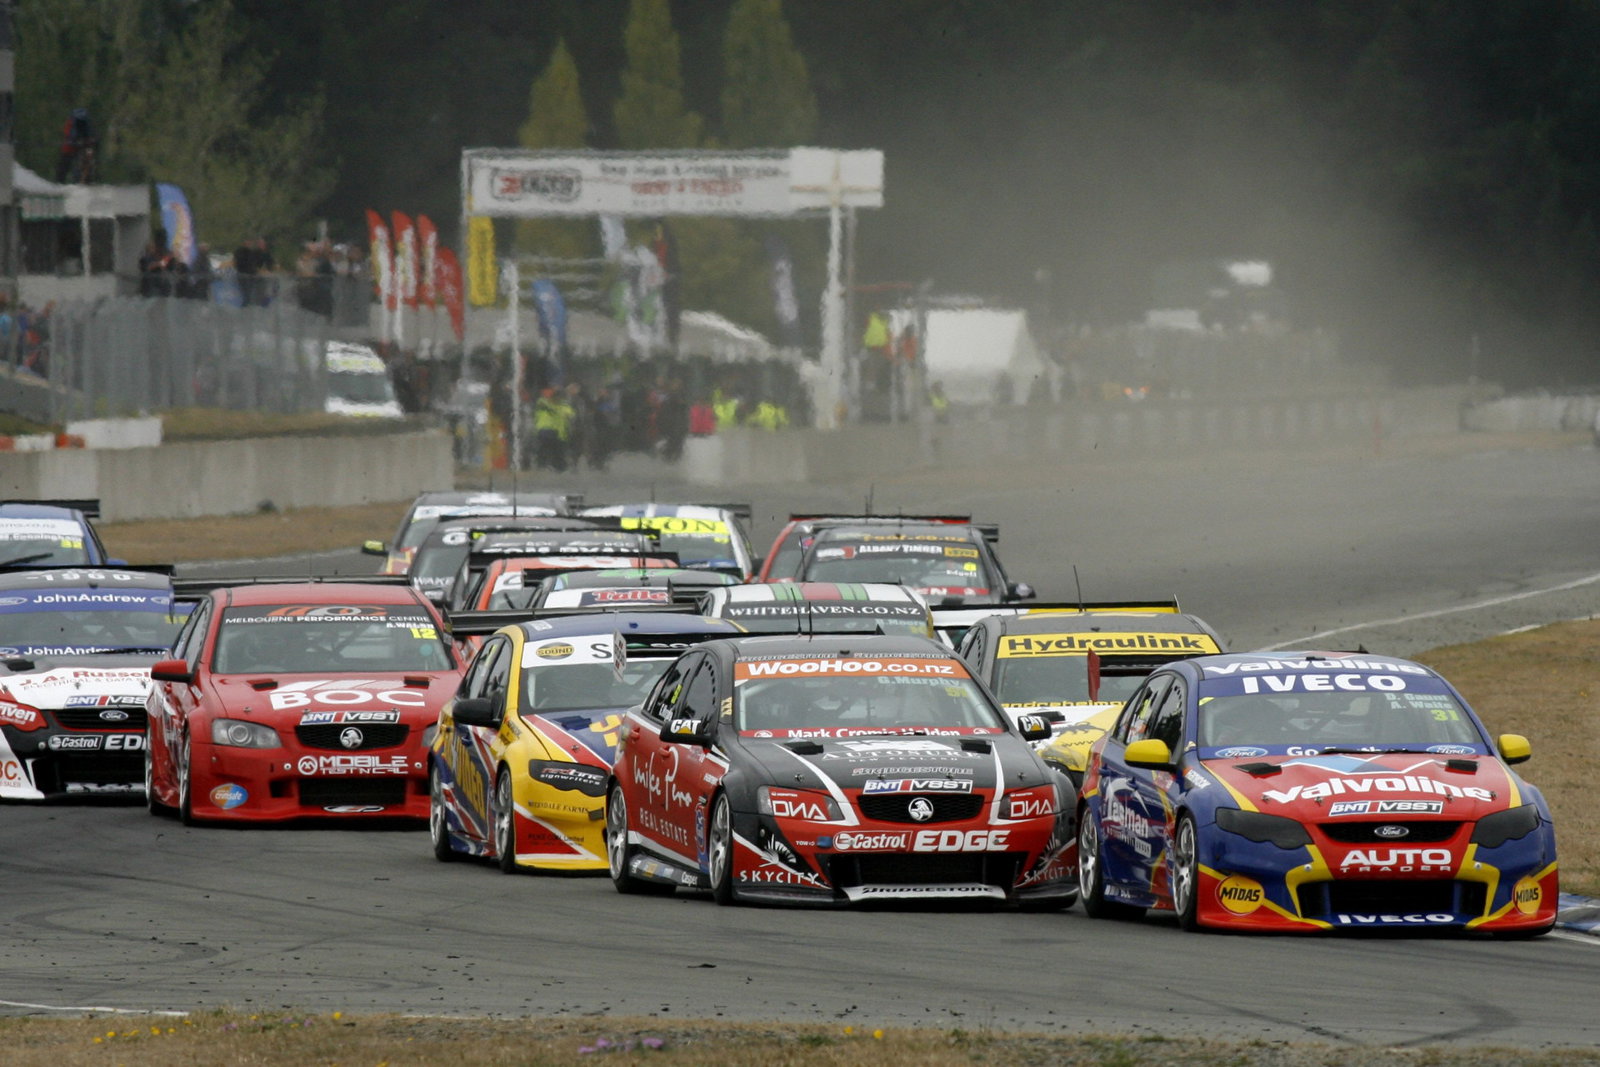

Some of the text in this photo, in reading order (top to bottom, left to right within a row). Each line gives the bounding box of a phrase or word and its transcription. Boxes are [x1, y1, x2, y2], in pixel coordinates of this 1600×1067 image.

[33, 594, 146, 603] JohnAndrew
[729, 606, 921, 616] WHITEHAVEN.CO.NZ
[226, 615, 293, 624] MELBOURNE
[297, 615, 386, 623] PERFORMANCE
[410, 628, 438, 640] 12
[1008, 635, 1203, 650] Hydraulink
[537, 646, 573, 656] SOUND
[748, 660, 954, 676] WooHoo.co.nz
[1205, 659, 1428, 675] Valvoline
[73, 671, 150, 679] Russel
[1243, 674, 1406, 694] IVECO
[109, 696, 146, 705] V8S
[269, 690, 425, 710] BOC
[0, 704, 36, 722] riven
[302, 712, 333, 723] BNT
[1430, 709, 1460, 721] 31
[671, 719, 701, 735] CAT
[1021, 715, 1045, 732] CAT
[61, 735, 146, 750] Castrol ED
[822, 750, 984, 760] AUTOSURE
[1287, 746, 1319, 757] Go
[320, 756, 409, 767] MOBILE
[865, 780, 972, 793] BNT V8ST
[1262, 776, 1492, 805] Valvoline
[1331, 801, 1442, 813] BNT V8ST
[639, 808, 659, 832] REAL
[660, 819, 689, 846] ESTATE
[852, 830, 1011, 852] Castrol EDGE
[1340, 849, 1452, 867] AUTO
[740, 871, 819, 885] SKYCITY
[1220, 887, 1261, 902] MIDAS
[1516, 887, 1540, 903] MIDAS
[1339, 914, 1455, 924] IVECO
